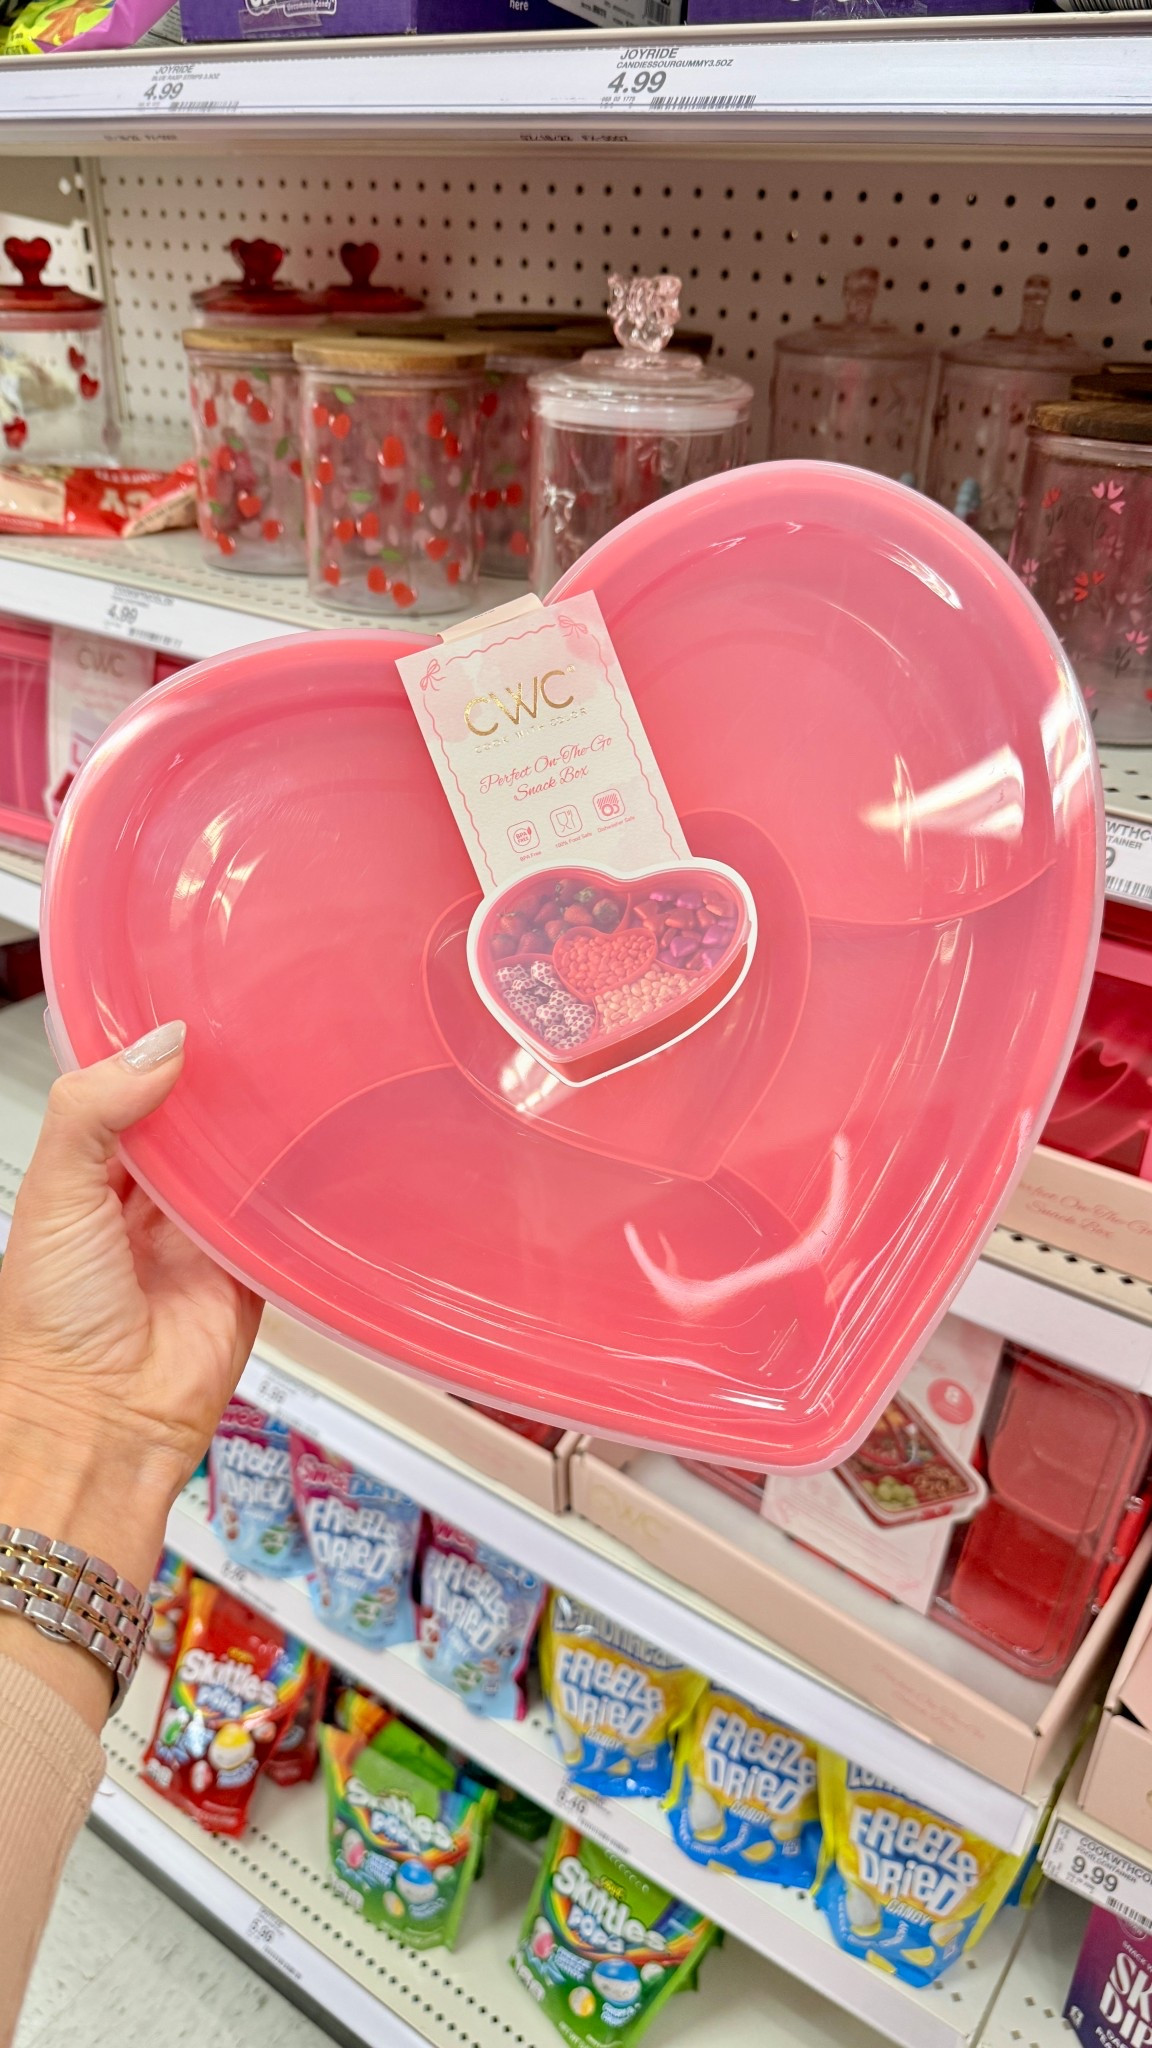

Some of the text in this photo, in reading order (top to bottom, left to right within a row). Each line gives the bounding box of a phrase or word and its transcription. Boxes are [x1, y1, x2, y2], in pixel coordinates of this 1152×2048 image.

[616, 59, 734, 69] CANDIESSOURGUMMY3.5OZ
[620, 47, 680, 60] JOYRIDE
[155, 64, 196, 75] JOYRIDE
[143, 82, 184, 101] 4.99
[607, 70, 668, 94] 4.99
[107, 603, 139, 625] 4.99
[463, 669, 574, 737] CWC
[474, 707, 588, 753] COOK WITH COLOR
[479, 734, 613, 795] Perfect On-The-Go
[513, 765, 589, 801] Snack Box
[515, 831, 528, 840] BPA
[517, 837, 530, 845] FREE
[568, 835, 582, 845] Food
[580, 830, 593, 841] Safe
[1106, 820, 1152, 842] WTHC
[519, 850, 542, 863] BPA Free
[729, 1799, 773, 1824] CANDY
[1070, 1854, 1119, 1893] 9.99
[551, 1854, 668, 1953] Skittles
[884, 1897, 936, 1927] CANDY
[1122, 1939, 1147, 1966] SNACK
